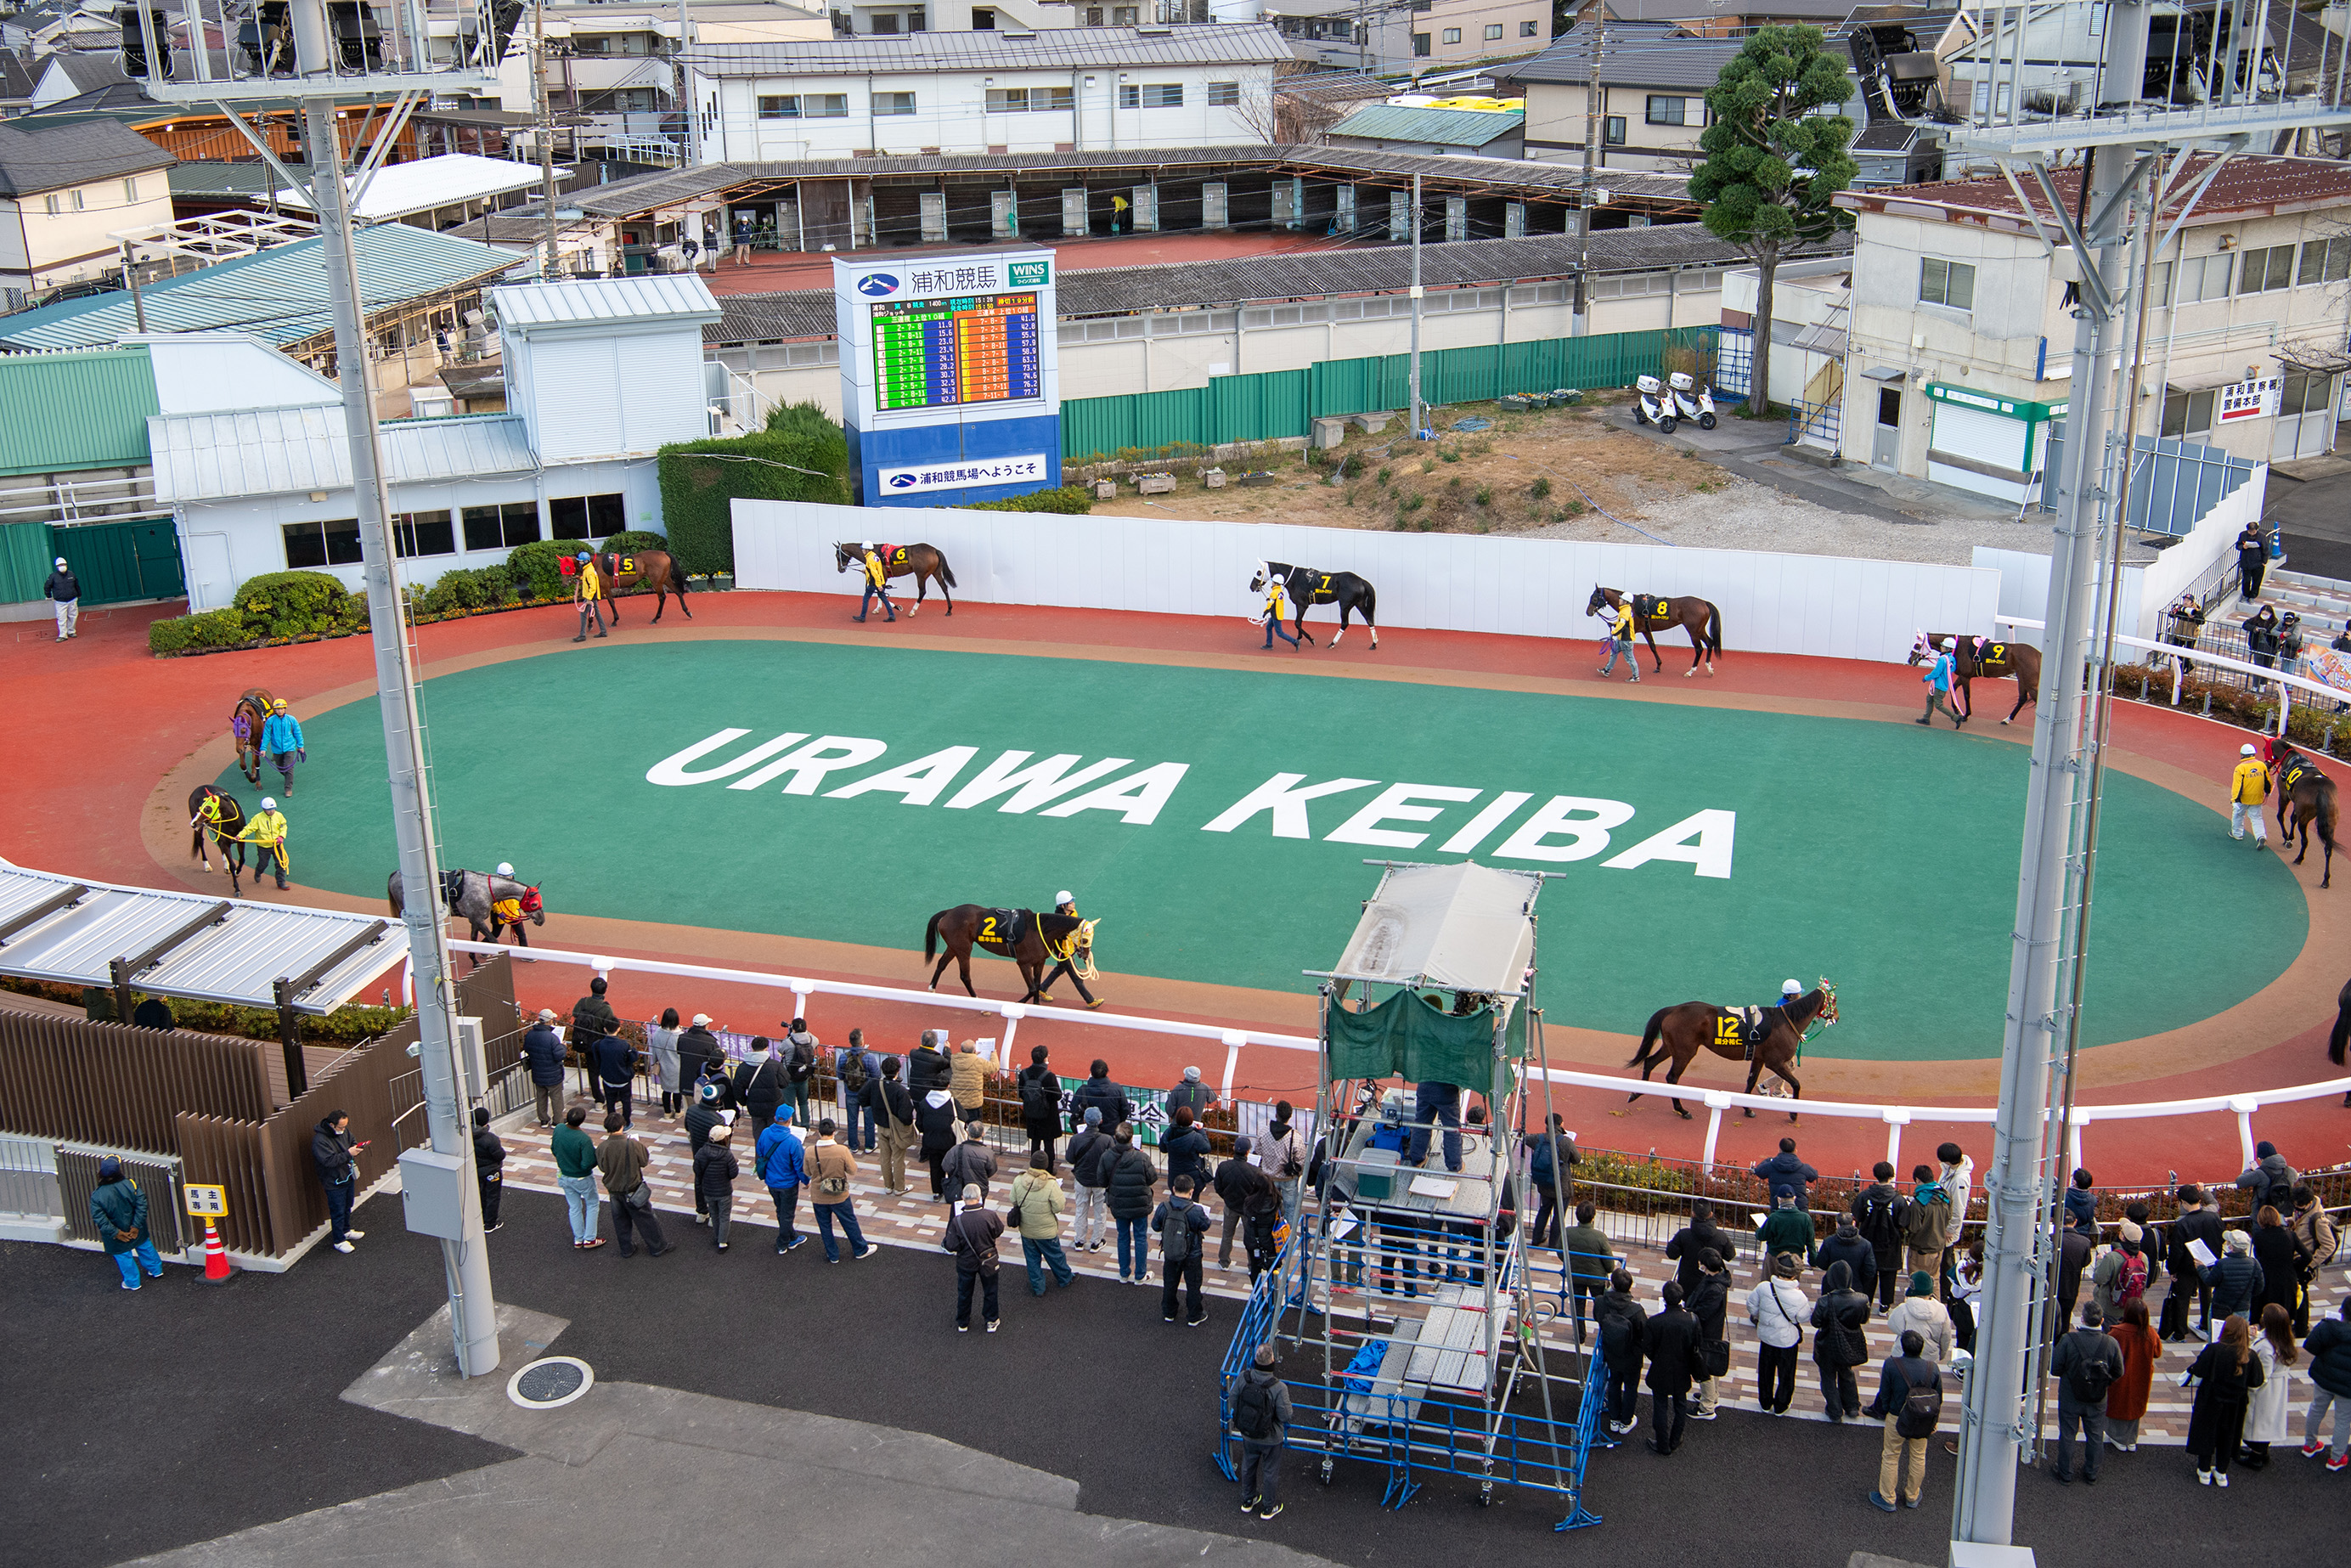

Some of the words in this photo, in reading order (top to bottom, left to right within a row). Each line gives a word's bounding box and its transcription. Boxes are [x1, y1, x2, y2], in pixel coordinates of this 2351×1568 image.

[1012, 264, 1045, 276] WINS
[912, 266, 997, 293] 浦和競馬
[2225, 378, 2278, 398] 浦和警察署
[2224, 394, 2261, 411] 警備本部
[920, 463, 1036, 485] 浦和競馬場へようこそ
[896, 548, 905, 560] 6
[623, 558, 633, 570] 5
[1321, 576, 1331, 589] 7
[1657, 601, 1667, 615] 8
[1993, 645, 2004, 658] 9
[2287, 767, 2303, 784] 10
[646, 728, 1190, 825] URAWA
[1201, 772, 1736, 879] KEIBA
[982, 917, 996, 936] 2
[1717, 1016, 1739, 1037] 12
[191, 1190, 217, 1199] 馬主
[192, 1201, 219, 1210] 専用
